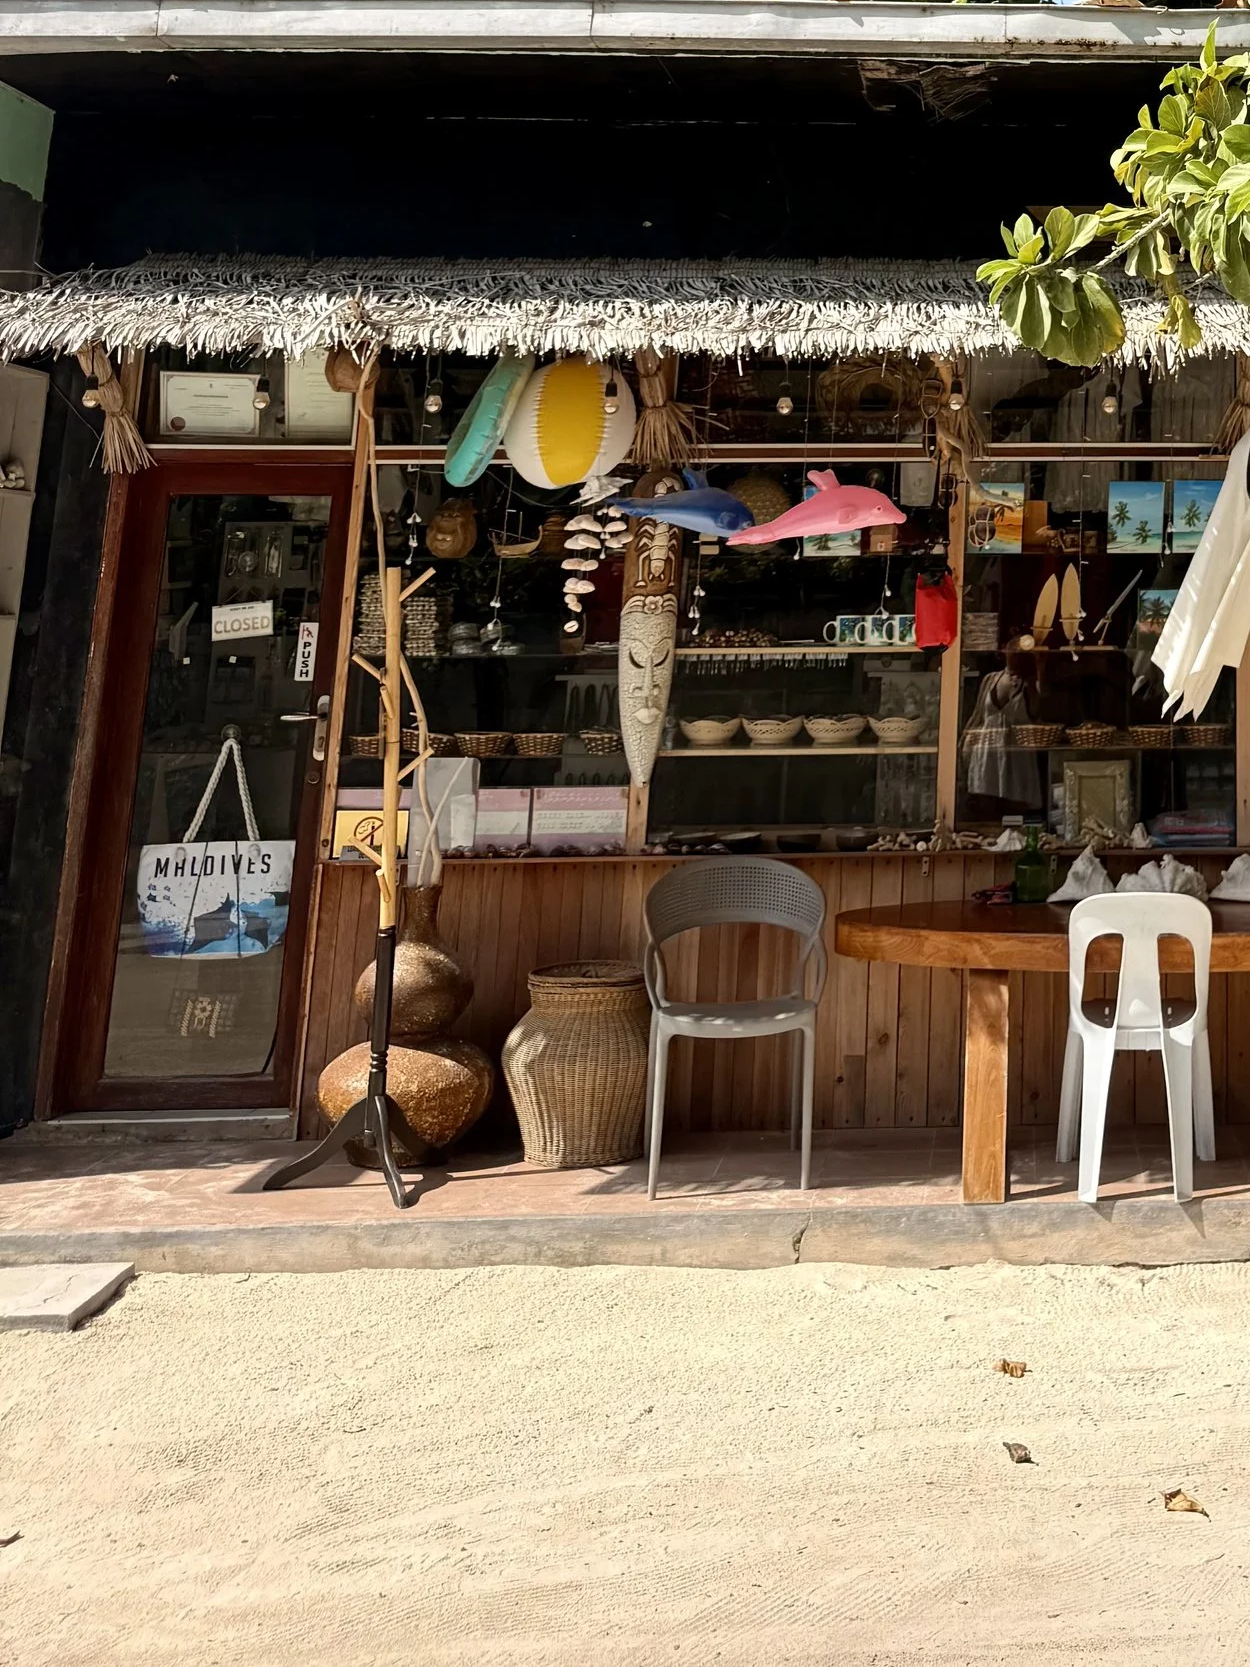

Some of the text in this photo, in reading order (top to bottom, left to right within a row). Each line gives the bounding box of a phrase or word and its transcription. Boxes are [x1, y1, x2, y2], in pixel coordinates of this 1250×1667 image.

[214, 616, 270, 634] CLOSED
[299, 641, 312, 678] PUSH
[154, 853, 271, 878] MALDIVES
